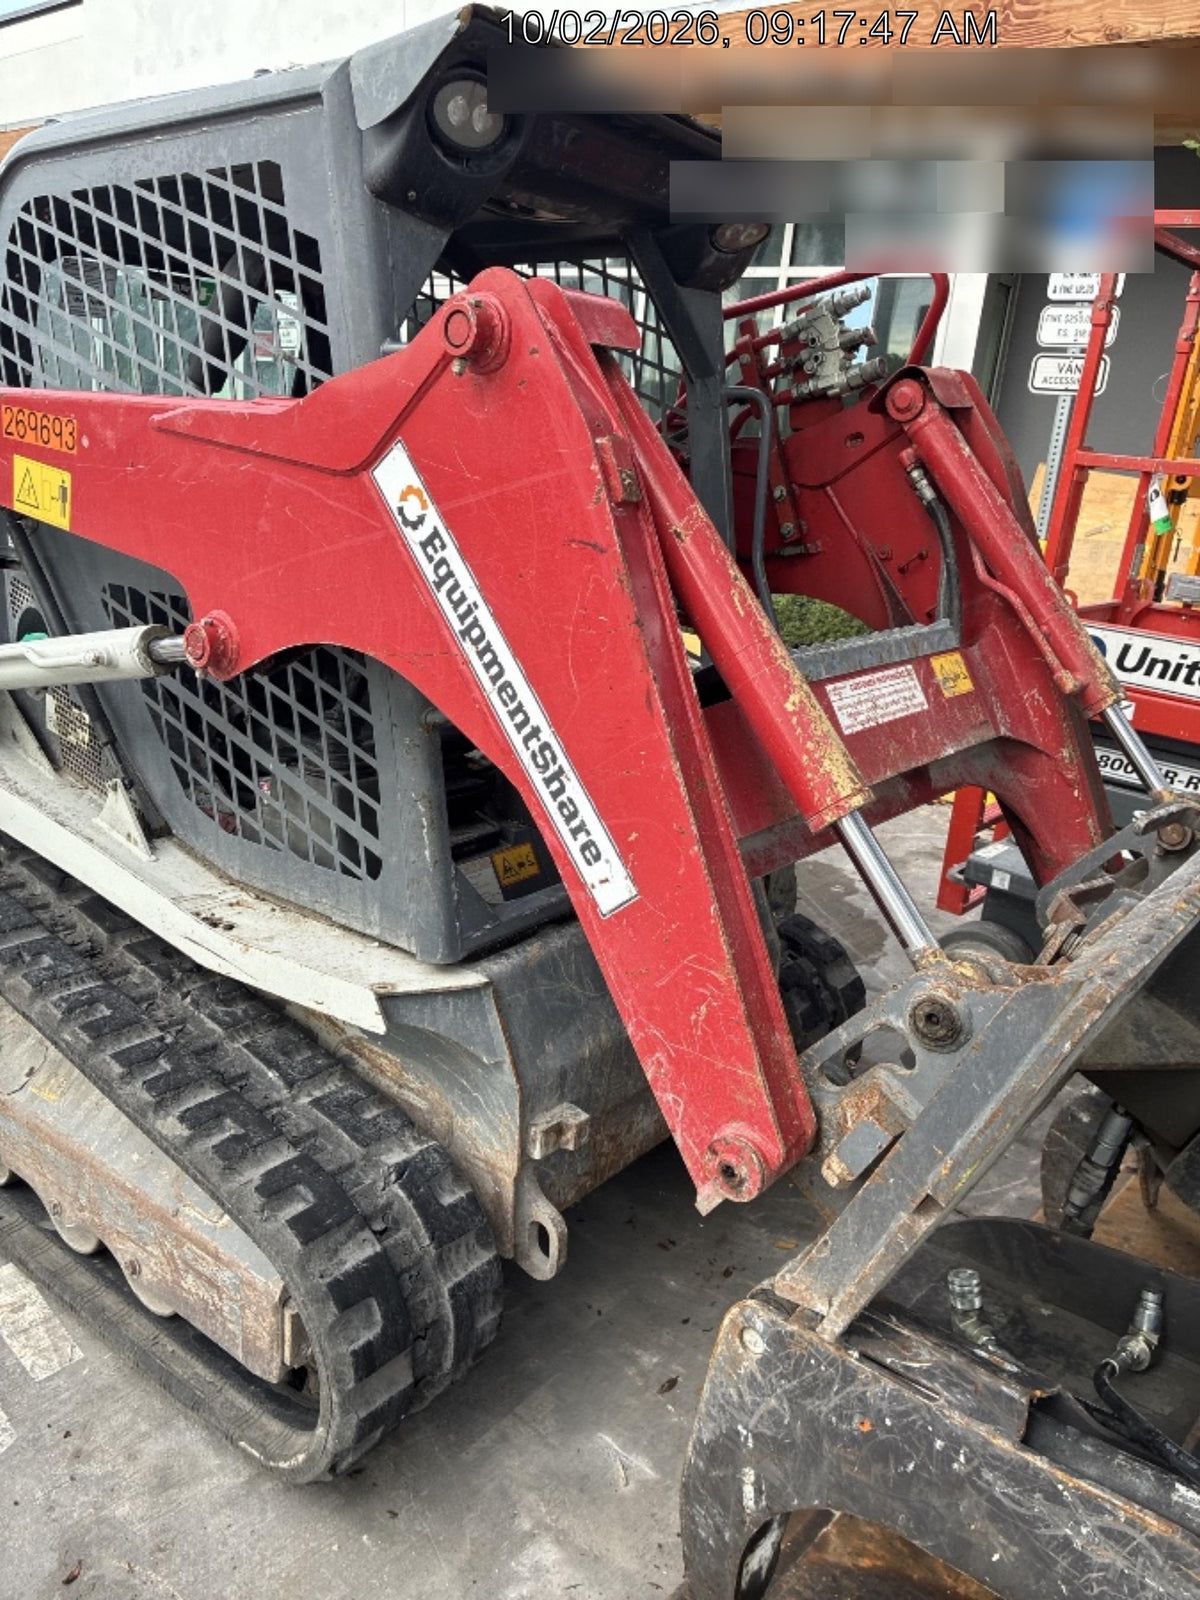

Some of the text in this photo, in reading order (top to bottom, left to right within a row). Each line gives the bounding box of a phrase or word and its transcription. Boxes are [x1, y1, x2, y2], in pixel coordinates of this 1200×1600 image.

[1057, 362, 1083, 375] VAN
[4, 406, 76, 451] 269693
[419, 525, 603, 867] EquipmentShare
